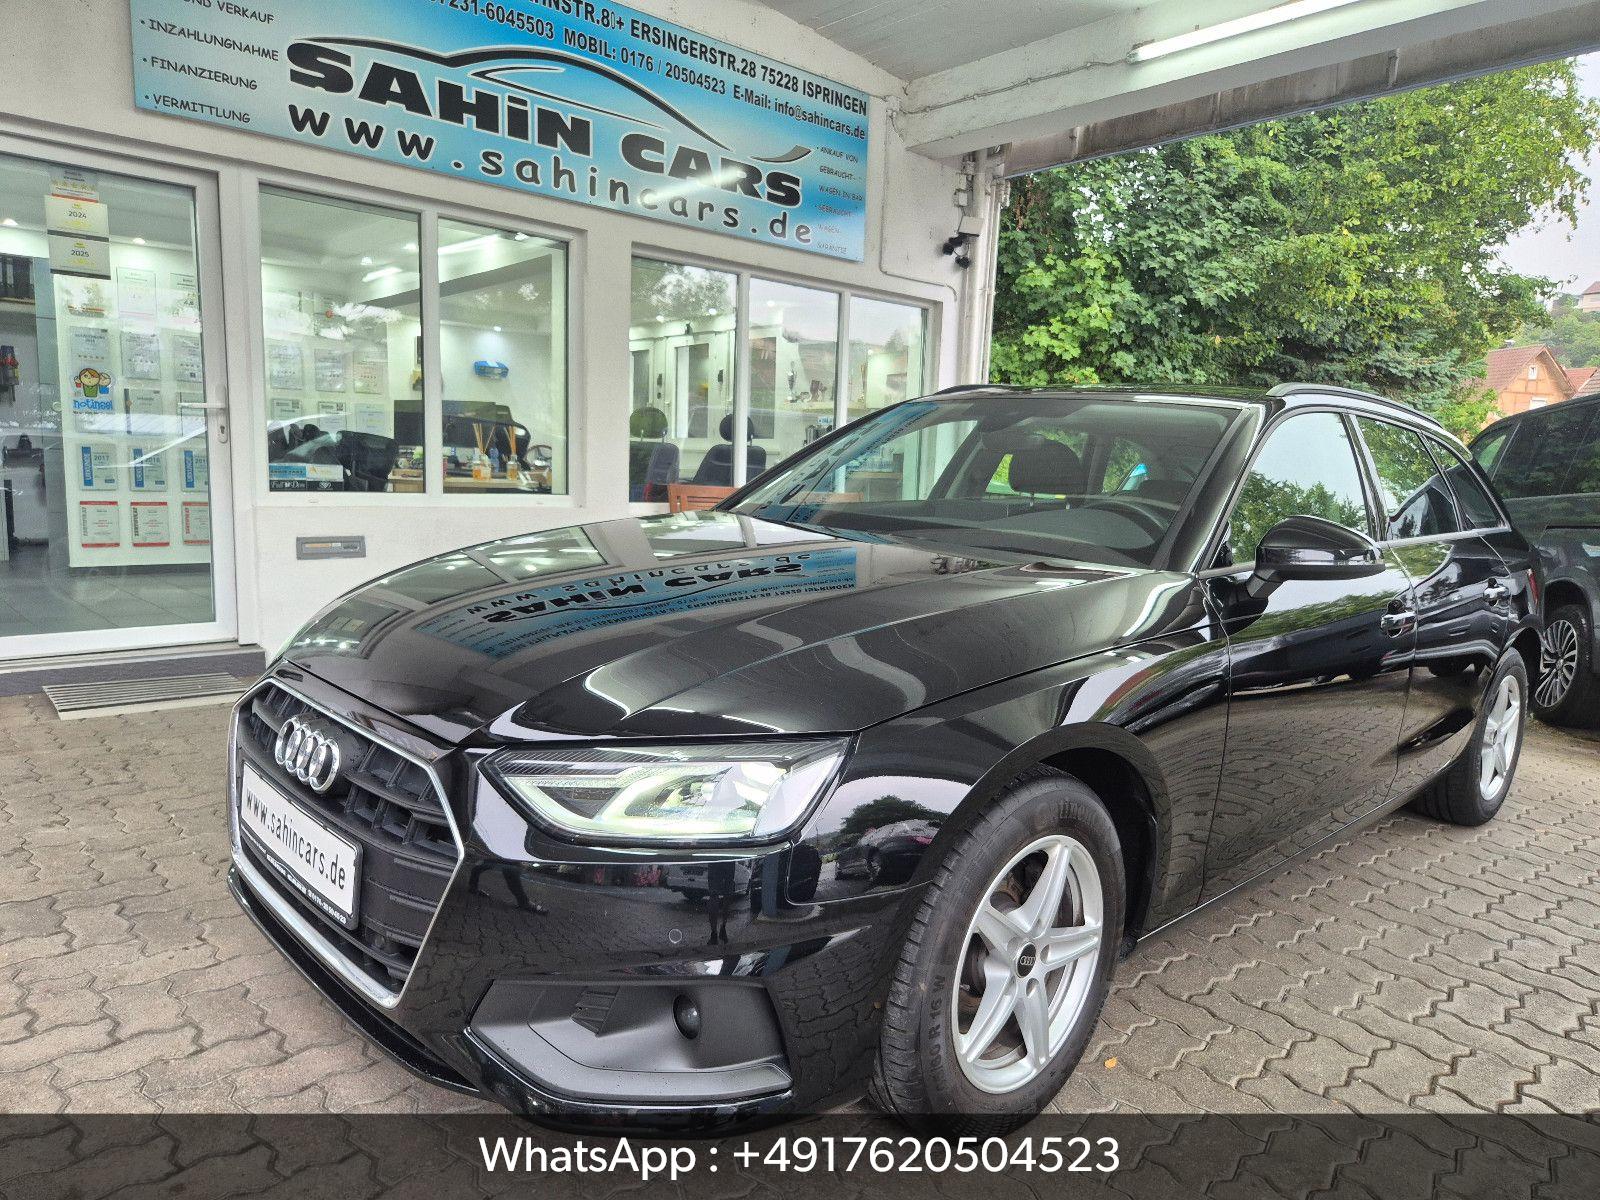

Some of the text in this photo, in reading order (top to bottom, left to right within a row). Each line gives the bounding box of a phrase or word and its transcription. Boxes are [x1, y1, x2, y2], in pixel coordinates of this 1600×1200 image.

[217, 0, 275, 24] VERKAUF
[148, 18, 279, 61] INZAHLUNGNAHME
[151, 55, 258, 90] FINANZIERUNG
[563, 27, 617, 60] MOBIL:
[620, 46, 654, 72] 0176
[665, 61, 726, 95] 20504523
[732, 84, 771, 110] E-Mail:
[774, 98, 866, 140] info@sahincars.de
[630, 18, 757, 79] ERSINGERSTR.28
[760, 64, 800, 93] 75228
[802, 78, 868, 117] ISPRINGEN
[152, 93, 251, 123] VERMITTLUNG
[621, 132, 802, 207] CARS
[68, 210, 87, 219] 2024
[71, 250, 89, 258] 2025
[245, 787, 346, 891] www.sahincars.de
